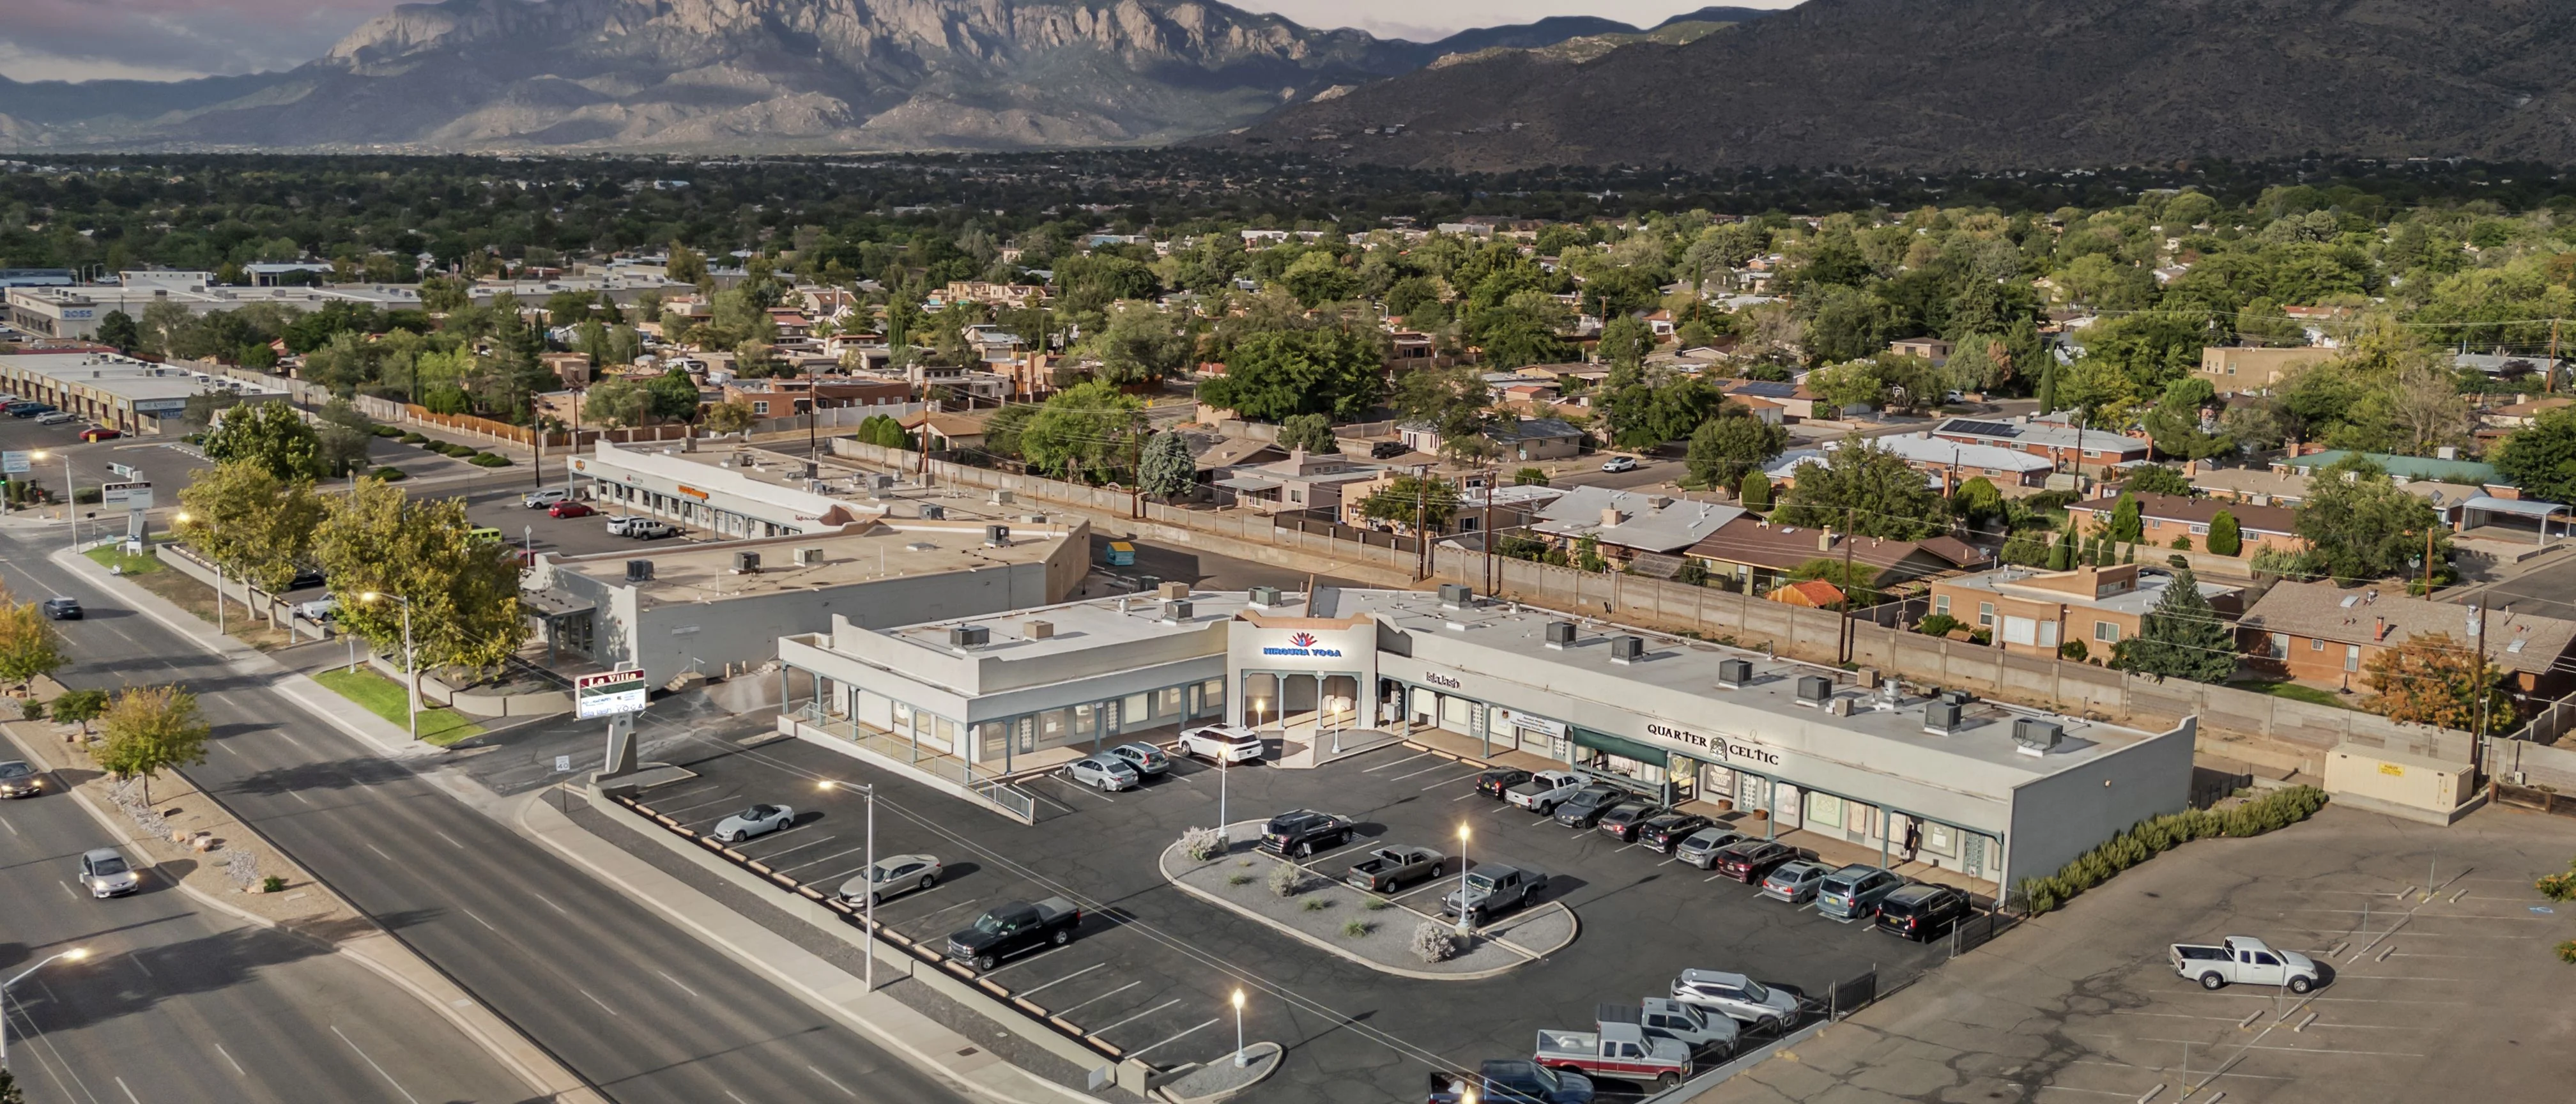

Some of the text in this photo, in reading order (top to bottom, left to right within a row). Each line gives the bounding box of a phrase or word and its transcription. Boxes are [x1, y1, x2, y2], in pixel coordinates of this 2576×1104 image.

[64, 310, 93, 318] ROSS
[1312, 648, 1342, 657] YOGA
[588, 673, 637, 687] La Villa
[1648, 724, 1779, 765] QUARTER CELTIC
